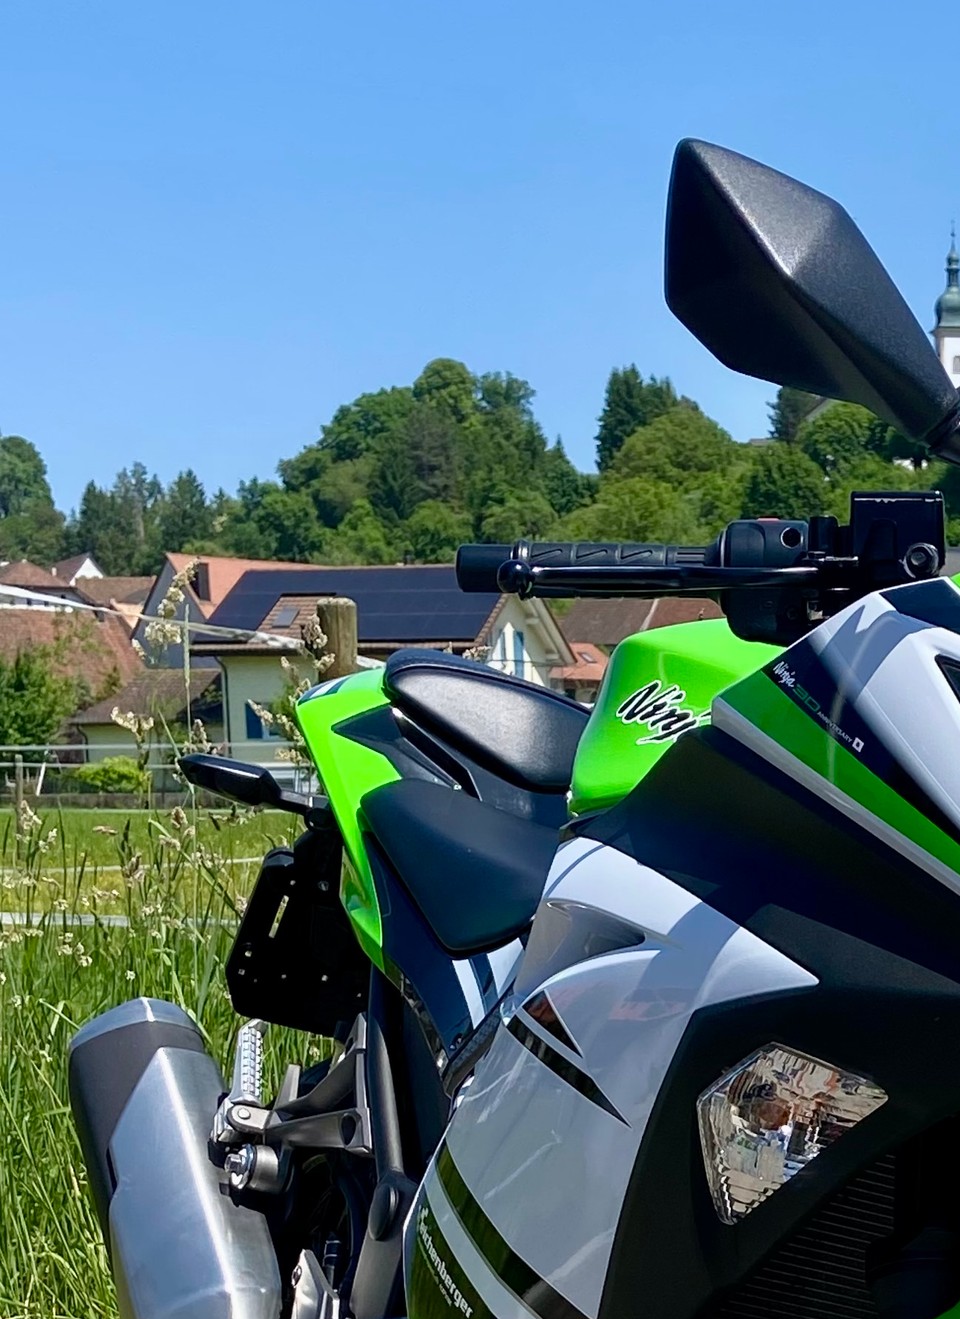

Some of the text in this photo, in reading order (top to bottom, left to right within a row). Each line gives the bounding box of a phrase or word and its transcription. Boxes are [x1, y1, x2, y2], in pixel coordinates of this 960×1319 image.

[616, 680, 711, 744] Ninj
[773, 661, 853, 743] Ninja 30 ANNIVERSARY
